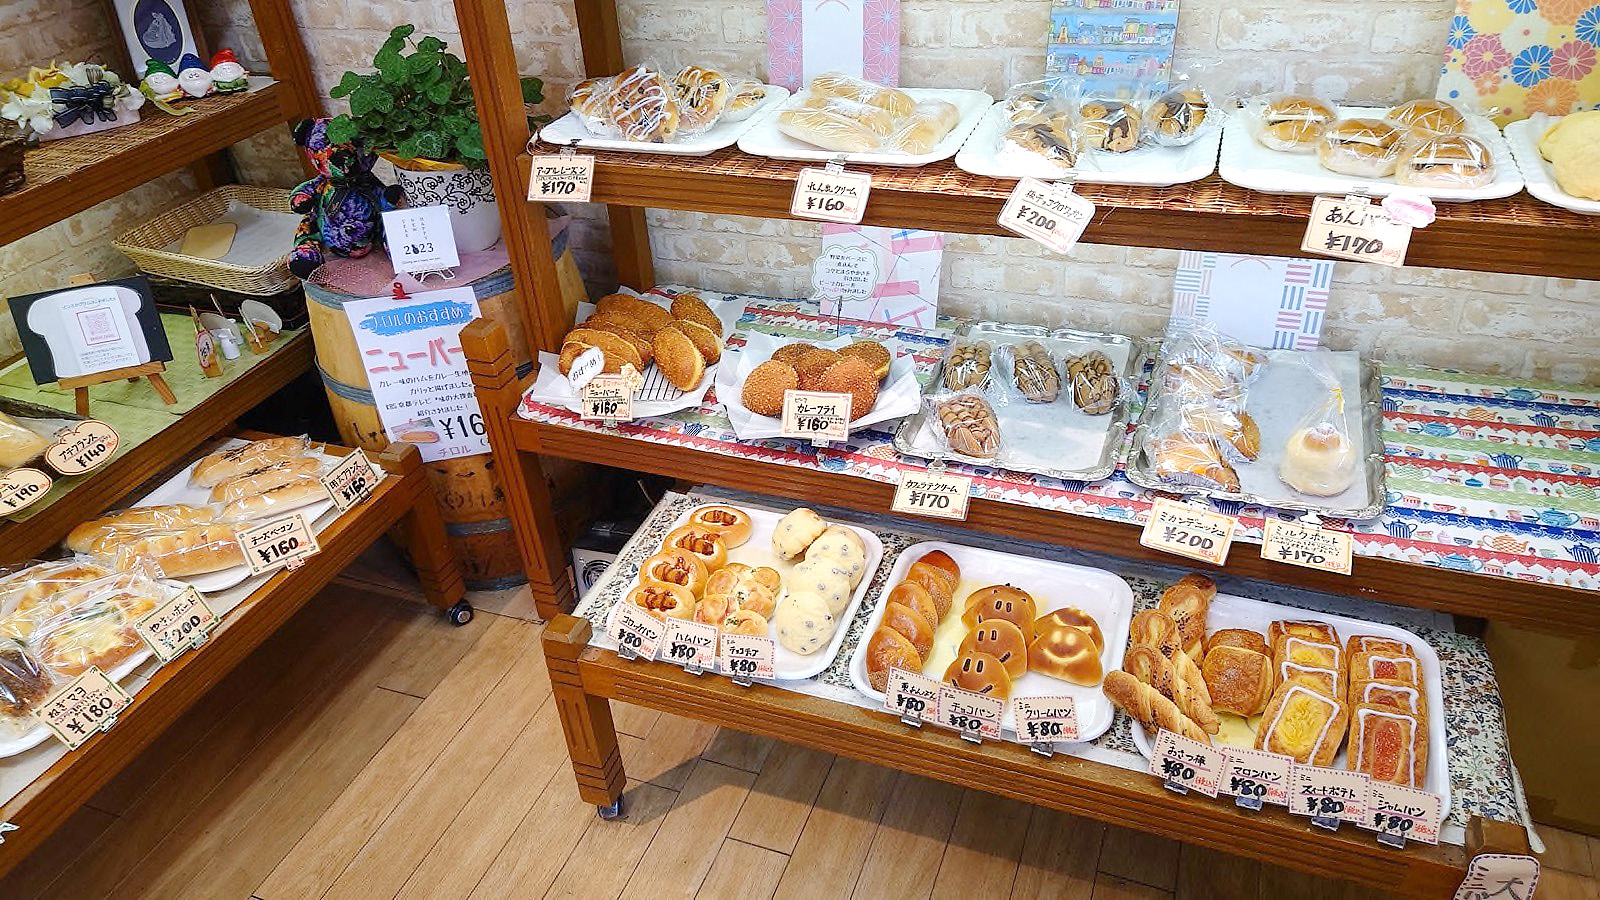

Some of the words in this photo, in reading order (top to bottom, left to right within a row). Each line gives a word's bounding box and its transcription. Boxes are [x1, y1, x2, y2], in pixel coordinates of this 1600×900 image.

[541, 180, 576, 195] ¥170
[806, 196, 845, 211] ¥160
[1015, 204, 1057, 231] ¥200
[1324, 230, 1384, 255] ¥170
[591, 401, 618, 416] ¥160
[797, 403, 837, 415] カレーフライ
[797, 417, 829, 431] ¥160
[75, 443, 107, 468] ¥140
[438, 445, 472, 458] チロル
[3, 483, 40, 508] ¥190
[341, 476, 367, 501] ¥160
[908, 490, 950, 509] ¥170
[250, 522, 295, 545] チーズベーコン
[1159, 511, 1226, 537] ミカンデニッシュ
[1162, 525, 1214, 550] ¥200
[1275, 525, 1339, 545] ミルクポット
[257, 536, 299, 564] ¥160
[1277, 545, 1326, 564] ¥170
[149, 594, 199, 634] やさいボード
[157, 615, 201, 650] ¥200
[621, 615, 658, 640] コロッケパン
[617, 628, 642, 648] ¥80
[675, 632, 712, 646] ハムパン
[669, 641, 697, 660] ¥80
[729, 658, 758, 673] ¥80
[48, 685, 88, 719] ねぎマヨ
[896, 693, 926, 712] ¥80
[951, 702, 996, 718] チョコパン
[1018, 701, 1031, 710] ミニ
[66, 696, 114, 735] ¥180
[949, 714, 982, 730] ¥80
[1025, 708, 1072, 719] クリームパン
[1026, 720, 1063, 738] ¥80
[1167, 745, 1207, 766] おさつ棒
[1228, 755, 1245, 764] ミニ
[1160, 757, 1195, 780] ¥80
[1232, 766, 1282, 781] マロンパン
[1299, 773, 1312, 782] ミニ
[1229, 776, 1268, 797] ¥80
[1306, 796, 1345, 814] ¥80
[1377, 799, 1426, 818] ジャムパン
[1373, 812, 1414, 832] ¥80
